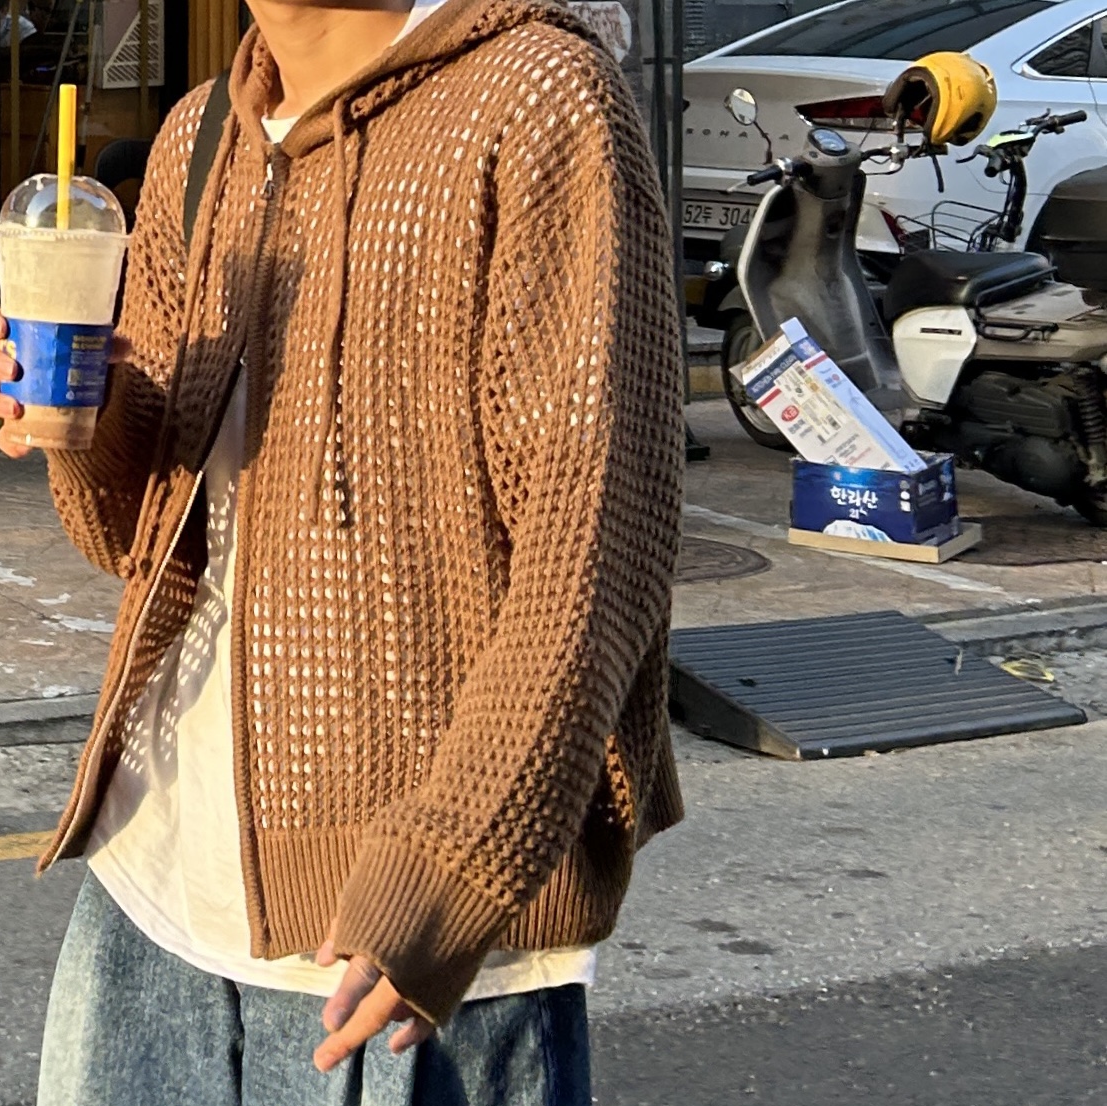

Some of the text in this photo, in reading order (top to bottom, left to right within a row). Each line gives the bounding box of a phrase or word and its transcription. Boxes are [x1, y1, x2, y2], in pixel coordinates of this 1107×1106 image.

[685, 127, 790, 140] SONAA
[683, 205, 758, 226] 52두 304
[830, 485, 878, 509] 한라산
